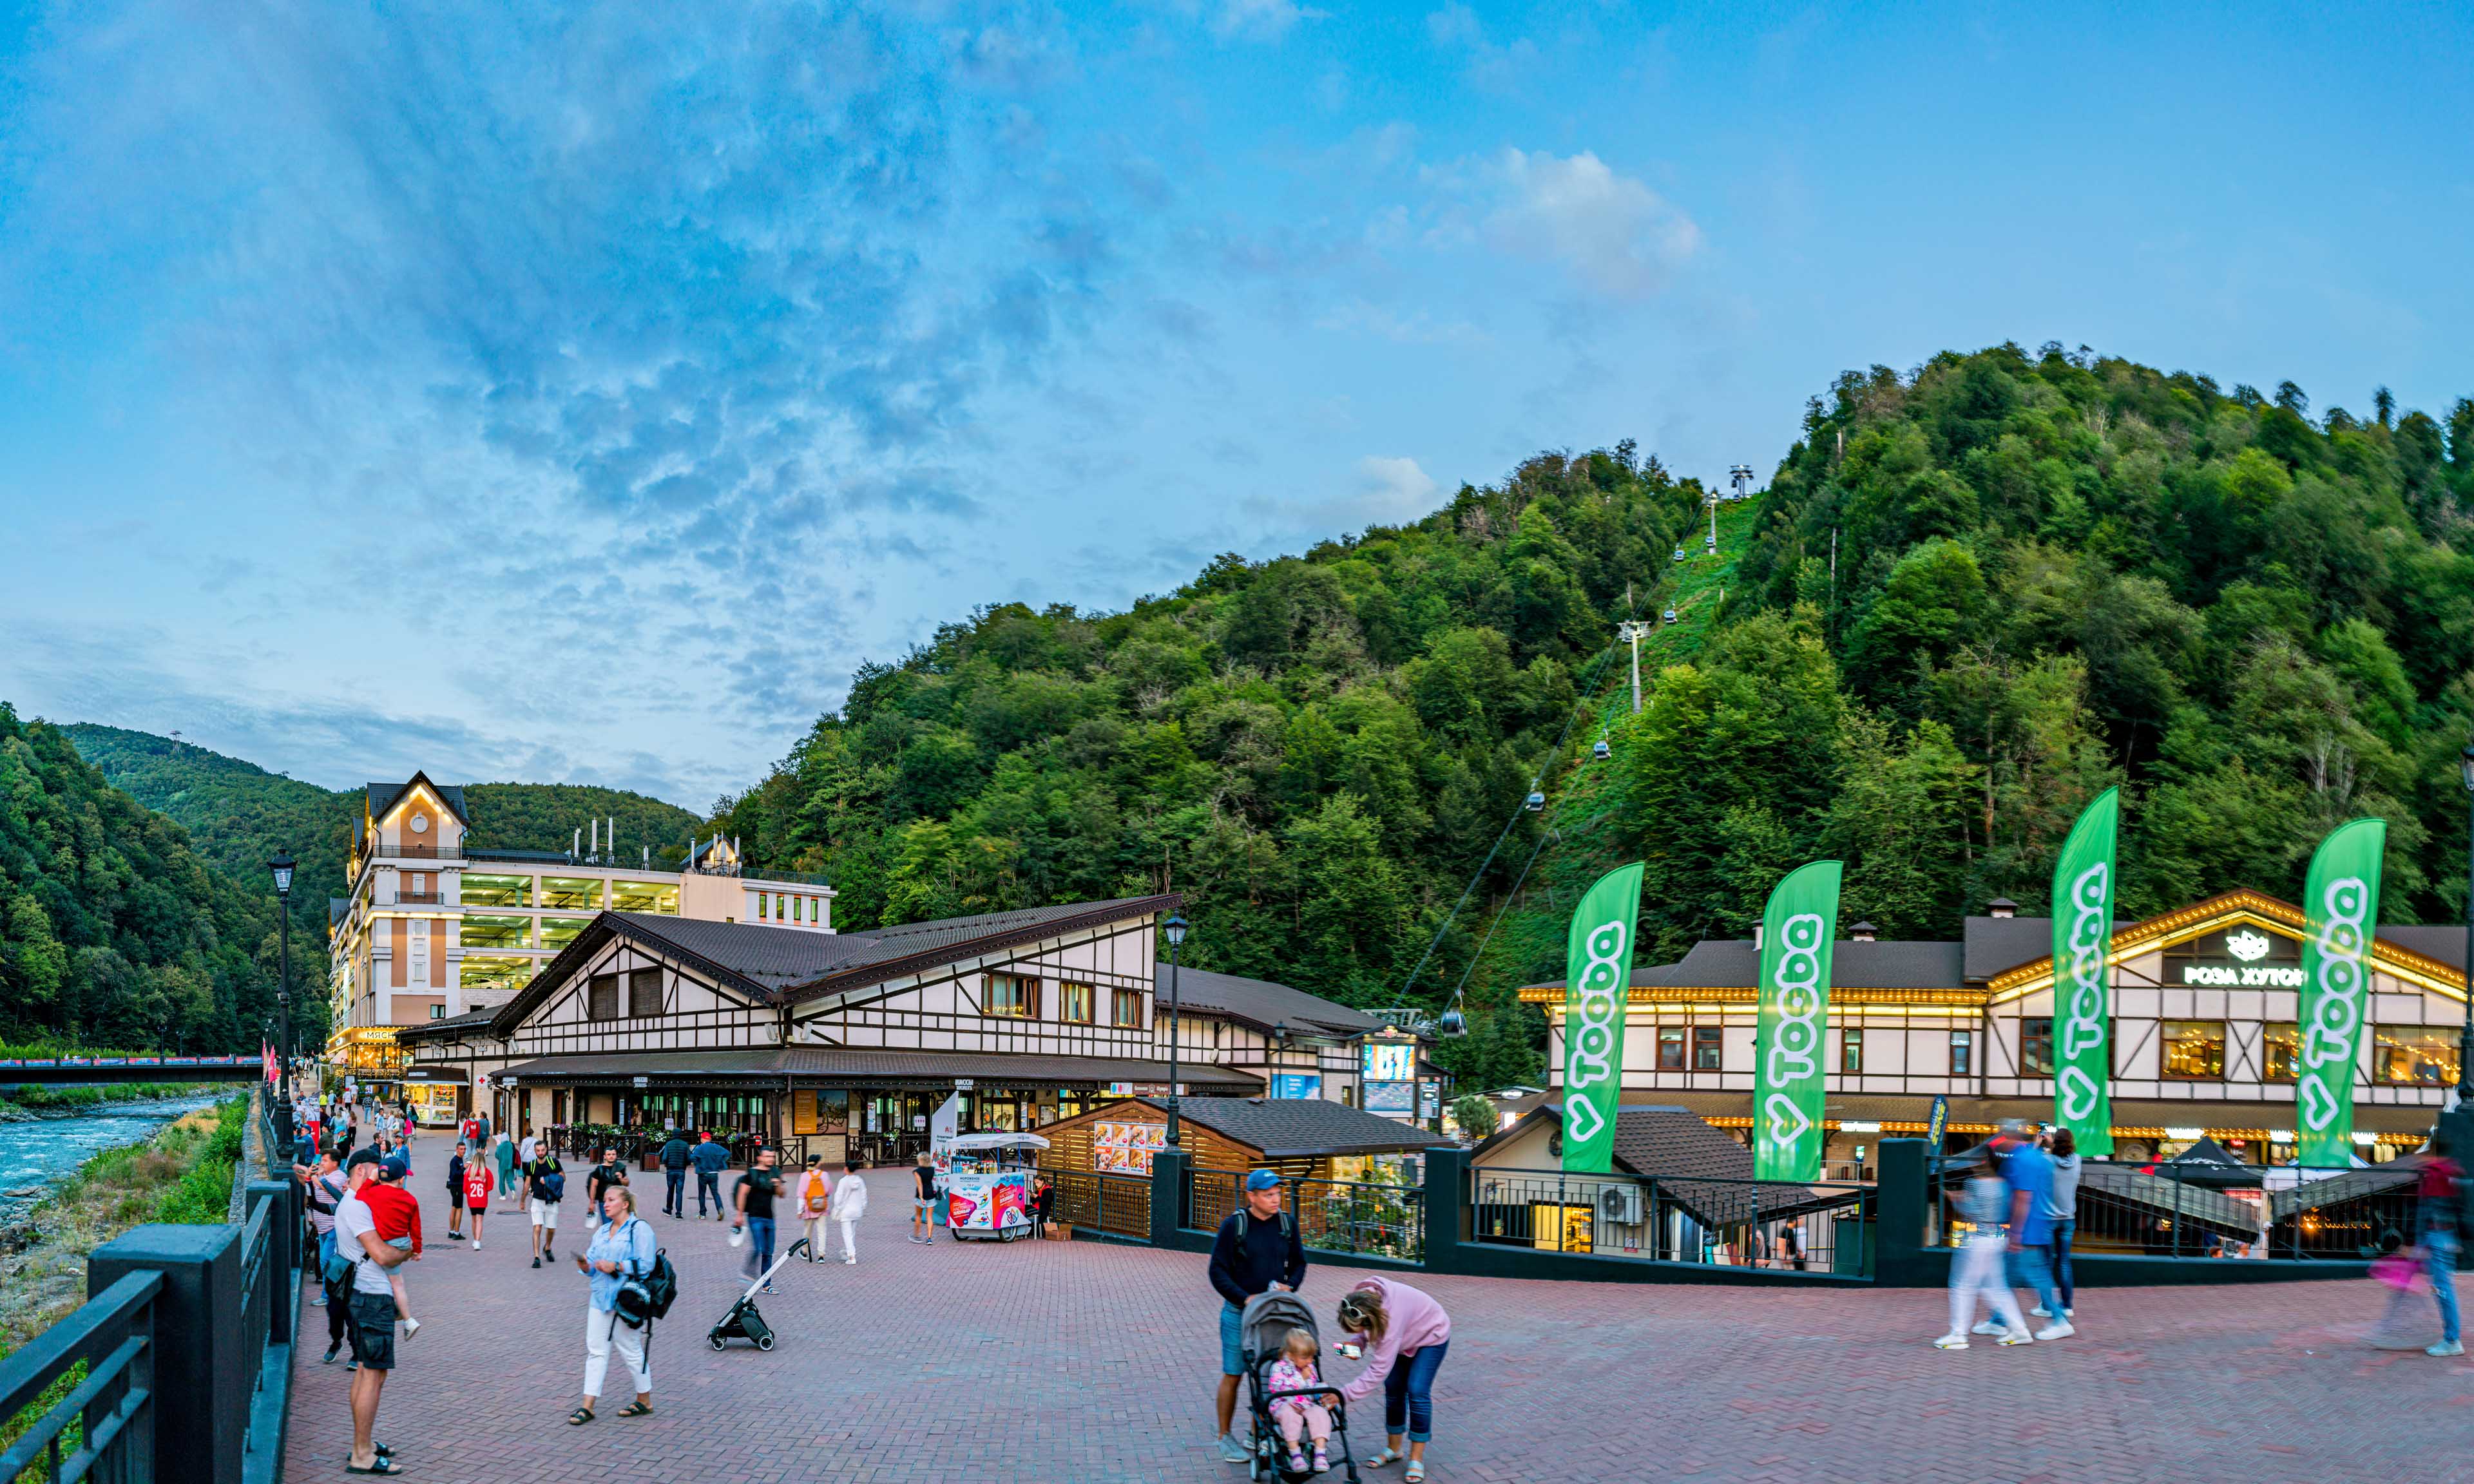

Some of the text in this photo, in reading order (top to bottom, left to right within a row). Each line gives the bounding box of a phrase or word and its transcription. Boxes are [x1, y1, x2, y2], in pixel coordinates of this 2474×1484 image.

[1569, 920, 1627, 1089] Tooba
[1767, 913, 1824, 1089] Tooba
[2064, 861, 2108, 1061] Tooba
[2185, 967, 2239, 985] РОЗА
[2304, 877, 2368, 1069] Tooba
[470, 1183, 484, 1197] 26
